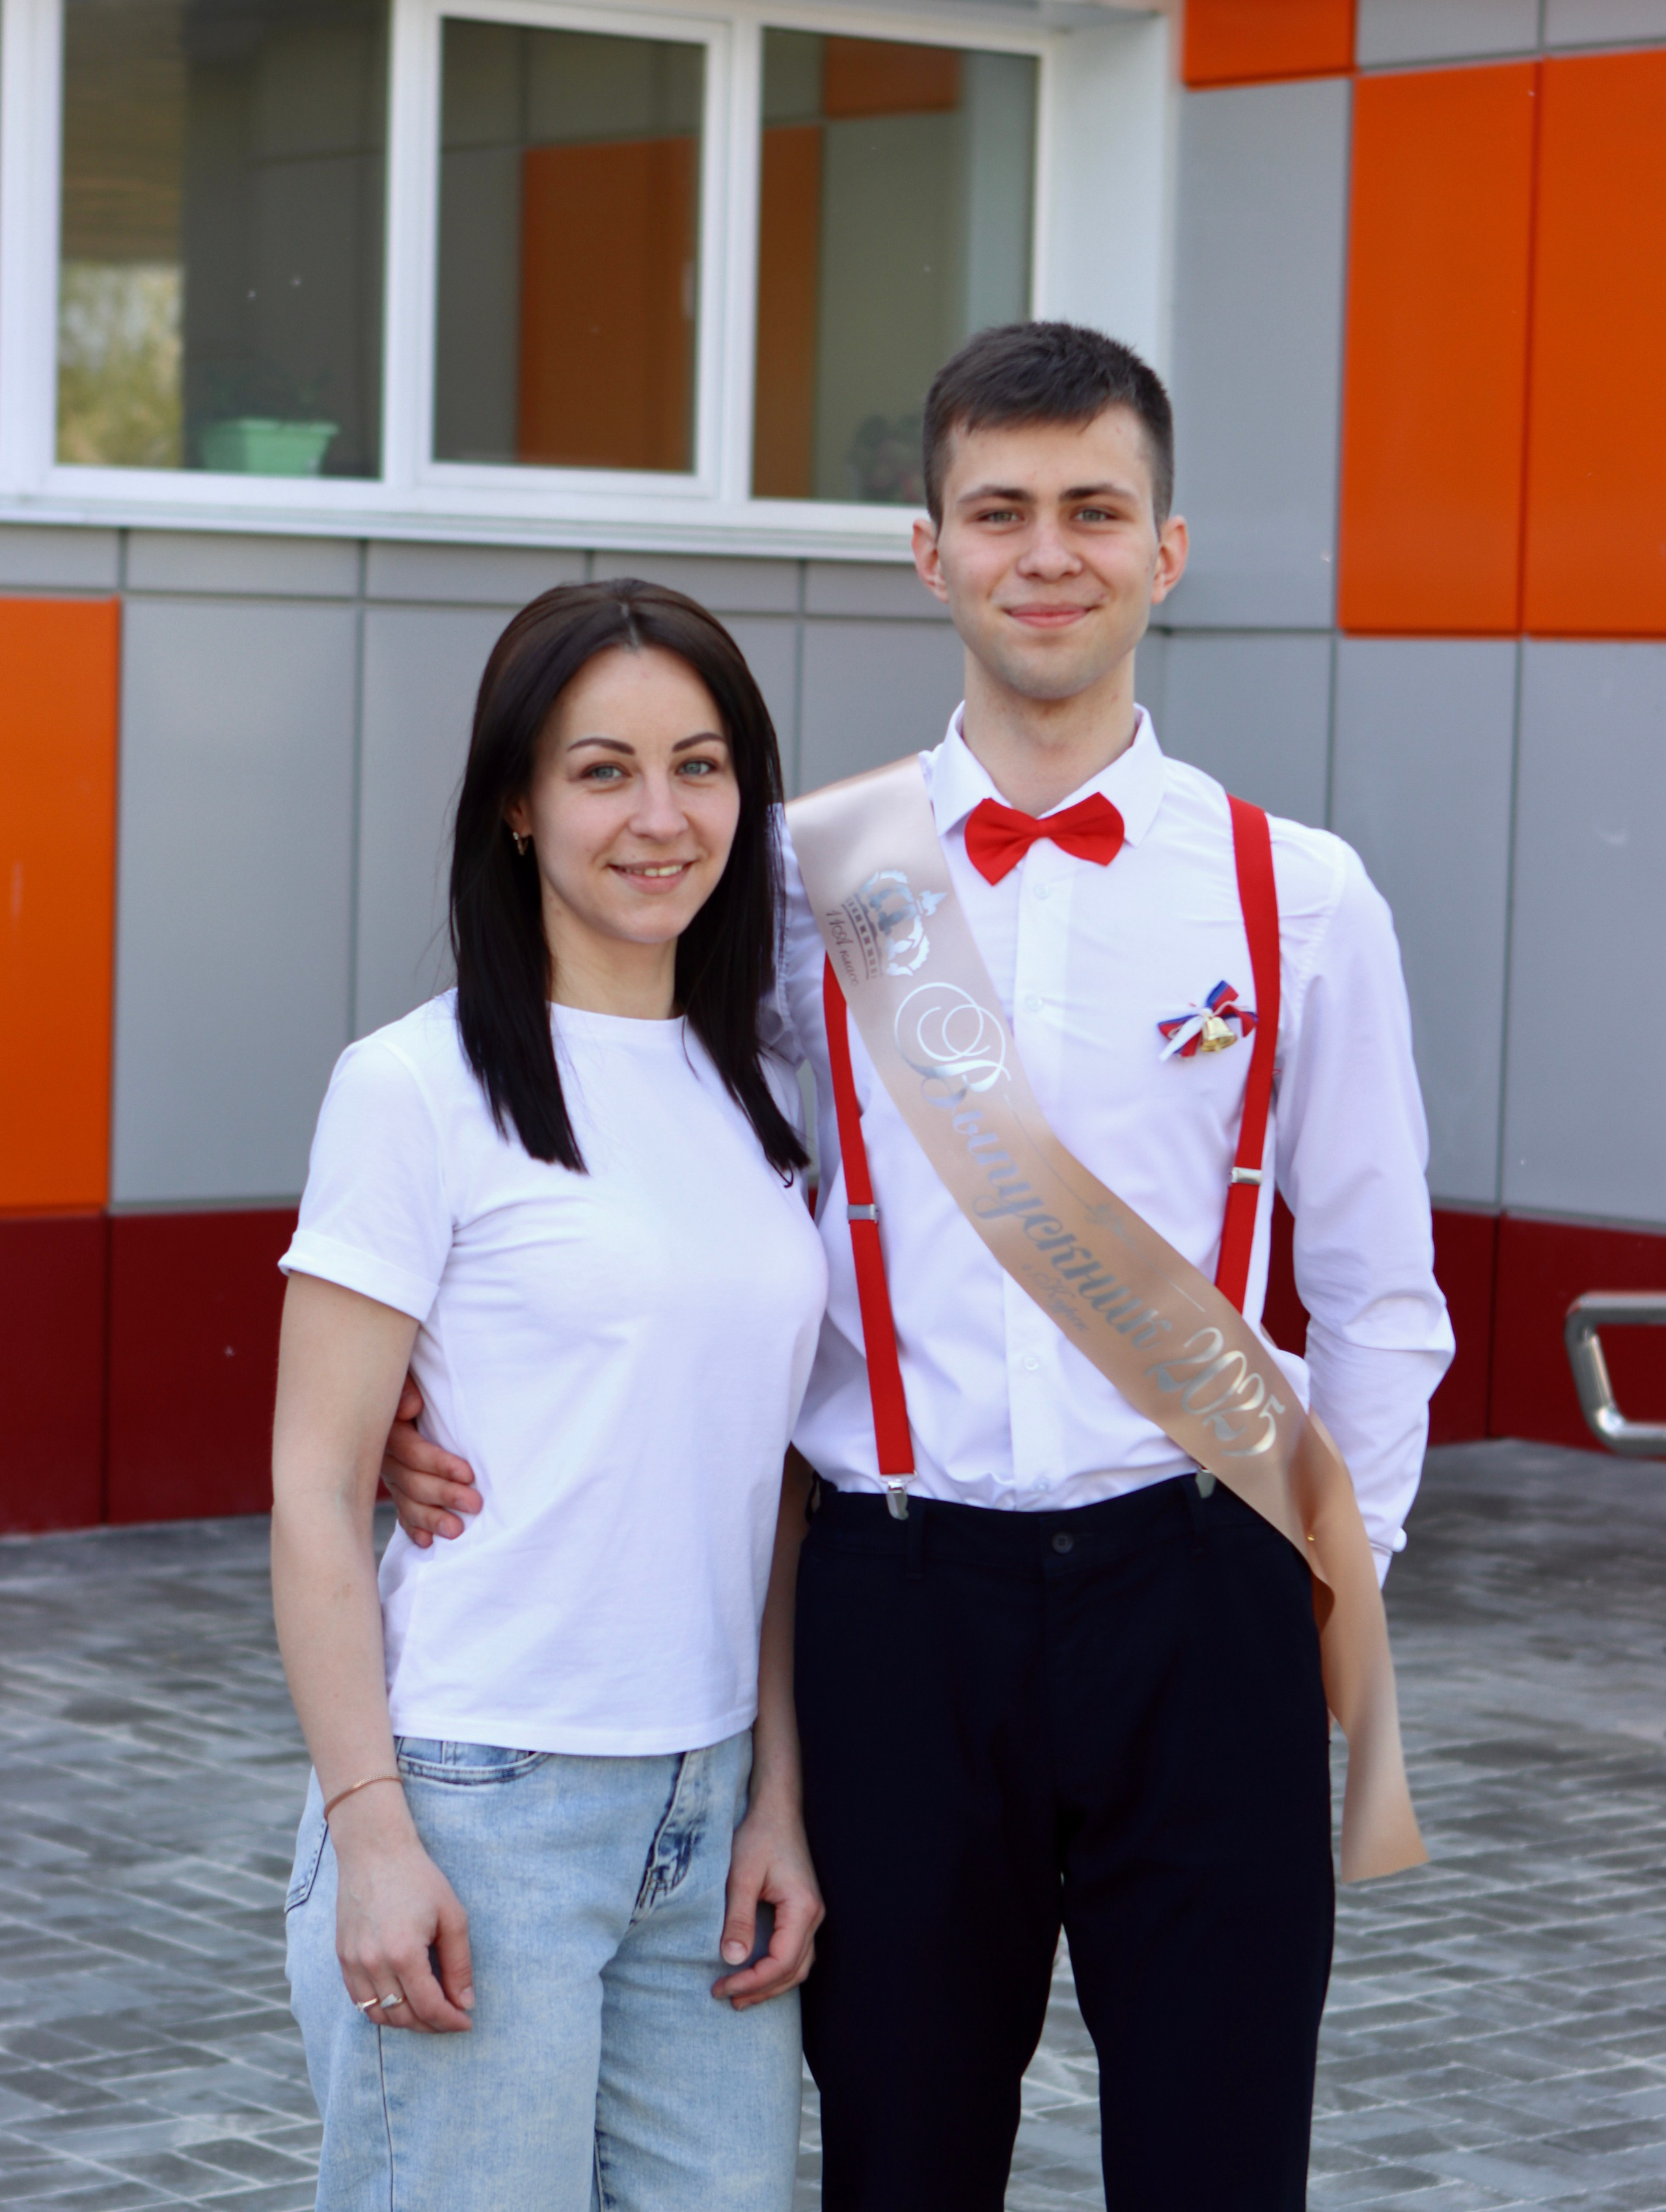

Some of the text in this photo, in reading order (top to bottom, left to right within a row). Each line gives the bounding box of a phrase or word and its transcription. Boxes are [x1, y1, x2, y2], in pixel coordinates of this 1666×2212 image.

[839, 950, 859, 987] класс
[894, 981, 1285, 1457] Выпускник 2025
